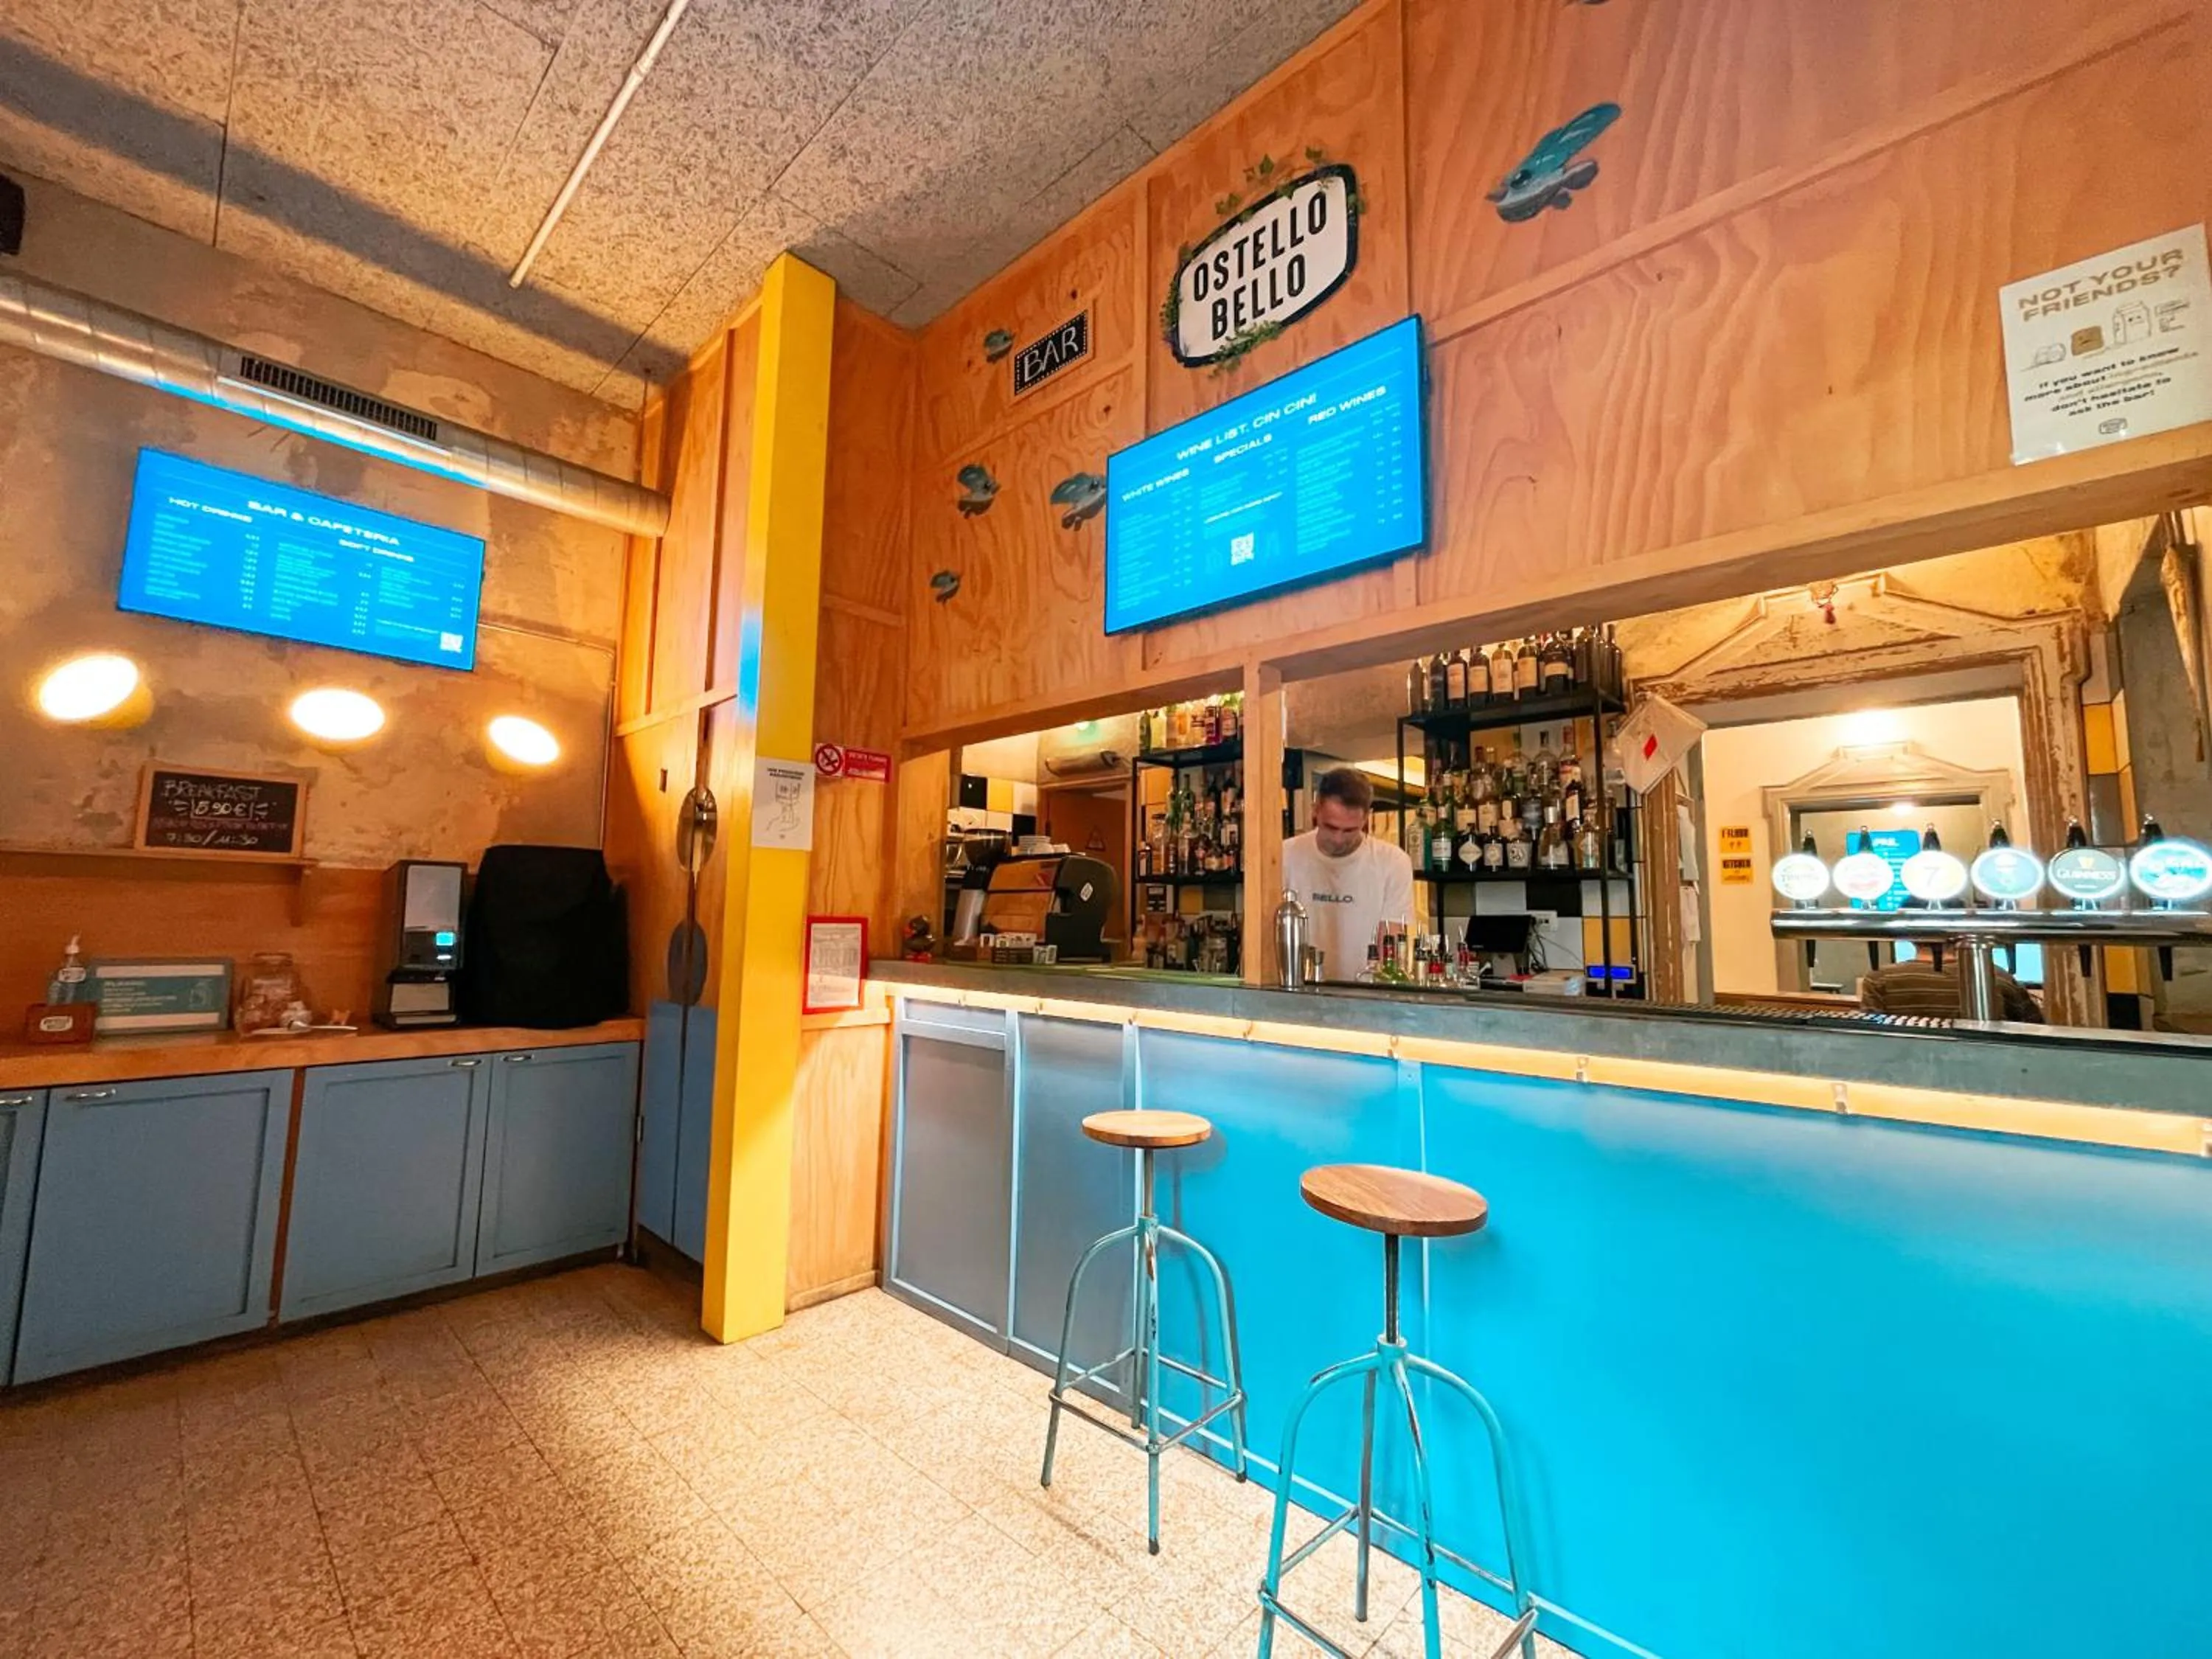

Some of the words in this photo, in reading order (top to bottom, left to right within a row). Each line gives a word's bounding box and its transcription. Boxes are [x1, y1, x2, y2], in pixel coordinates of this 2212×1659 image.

[1192, 190, 1327, 303] OSTELLO
[1211, 254, 1306, 341] BELLO
[2018, 279, 2082, 310] NOT
[2088, 248, 2184, 284] YOUR
[2023, 264, 2181, 322] FRIENDS?
[1022, 325, 1079, 383] BAR
[2053, 375, 2078, 386] you
[2065, 375, 2107, 392] about
[1175, 437, 1214, 461] WINE
[1253, 408, 1281, 430] CIN
[1284, 392, 1318, 417] CIN!
[1307, 406, 1337, 425] RED
[1339, 385, 1387, 411] WINES
[1213, 434, 1273, 465] SPECIALS
[169, 496, 200, 510] HOT
[248, 500, 288, 518] BAR
[307, 516, 400, 546] CAFETERIA
[162, 779, 262, 801] BREAKFAST
[2056, 867, 2117, 882] GUINNESS
